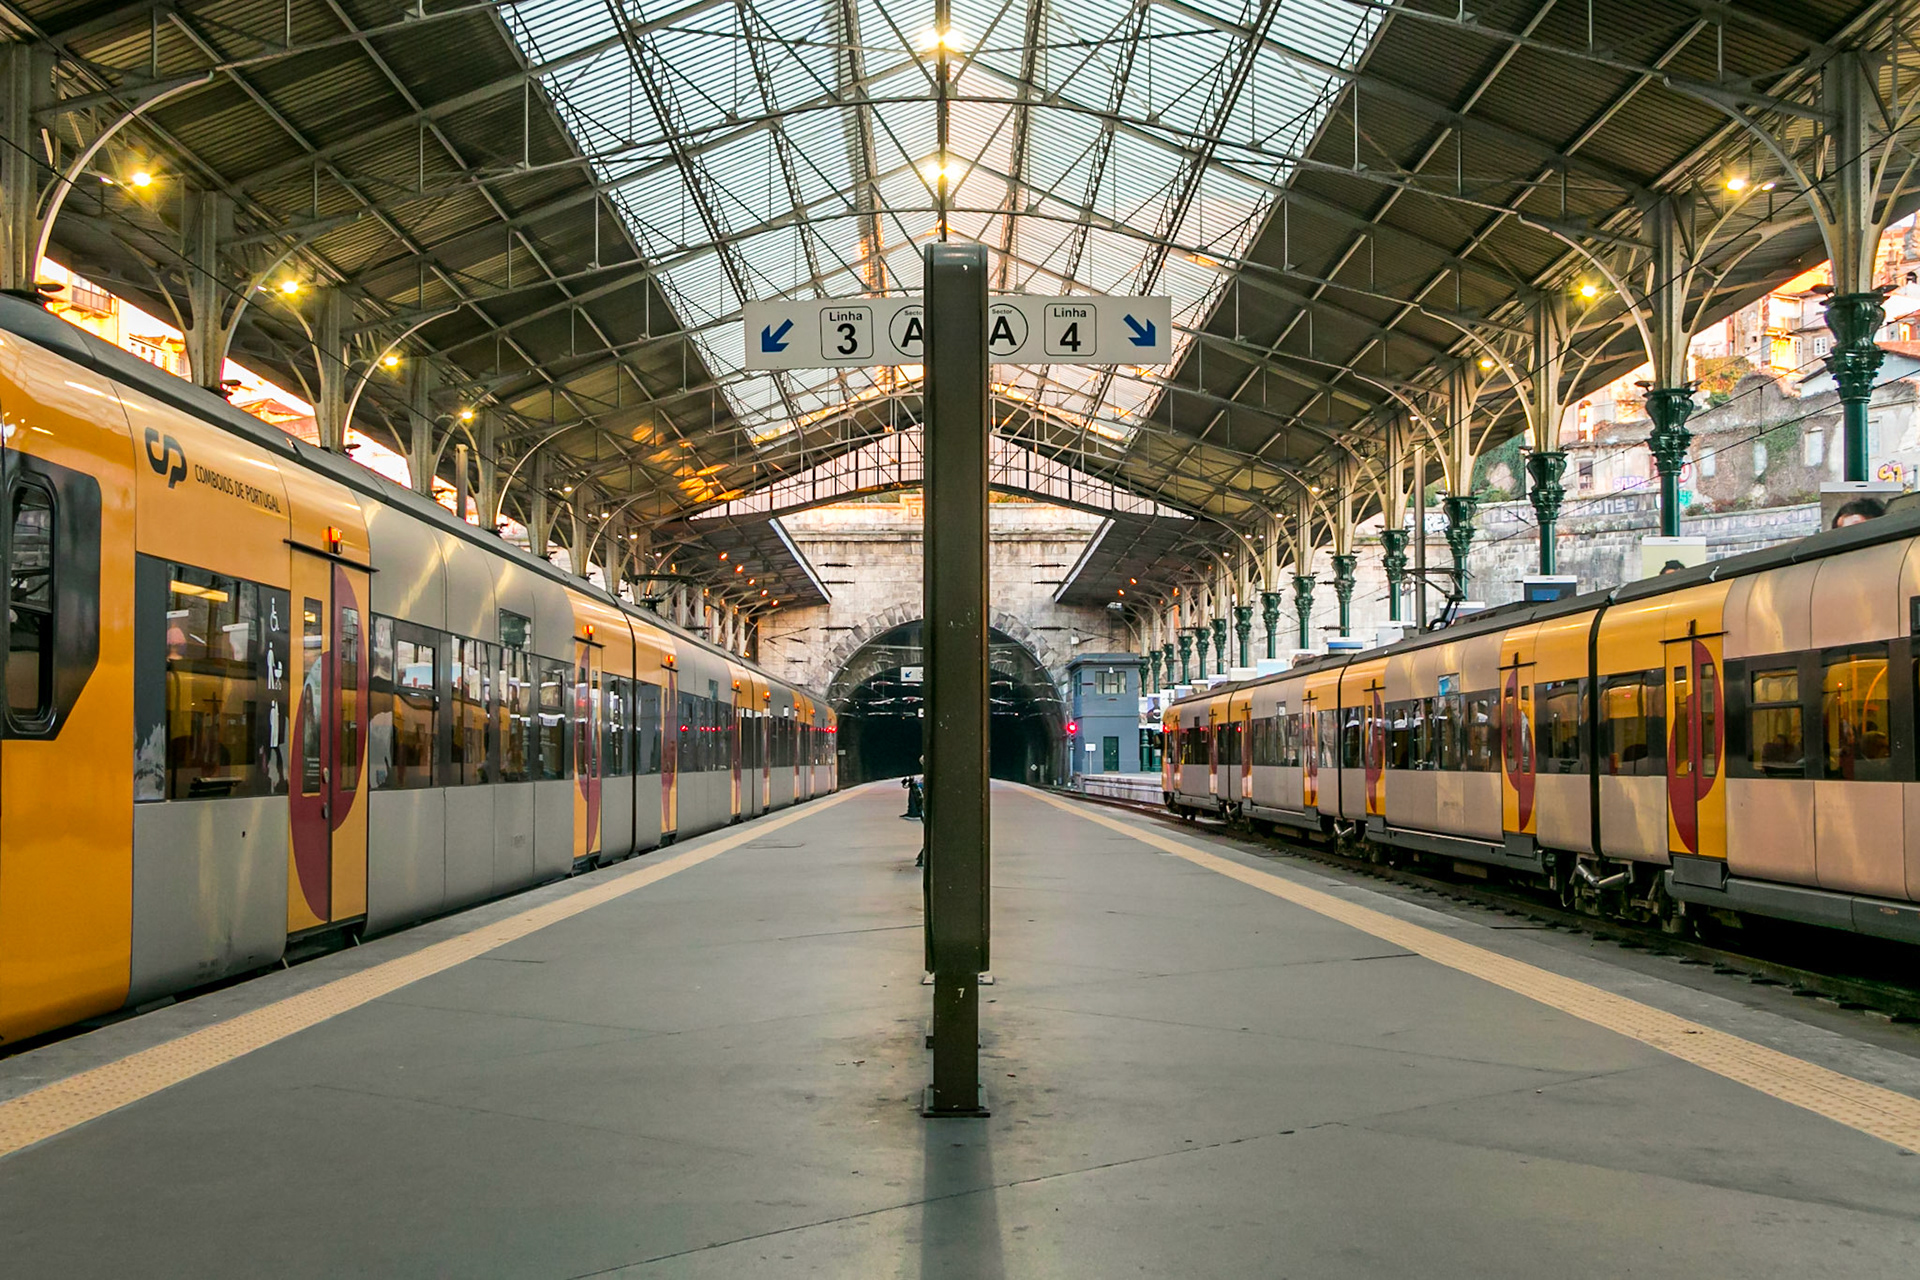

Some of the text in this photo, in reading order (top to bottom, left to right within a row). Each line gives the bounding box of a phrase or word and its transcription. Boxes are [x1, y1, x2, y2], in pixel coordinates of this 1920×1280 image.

[829, 311, 863, 322] Linha
[1053, 307, 1087, 318] Linha
[837, 323, 858, 355] 3
[901, 317, 923, 348] A
[989, 316, 1017, 346] A
[1059, 322, 1081, 352] 4
[194, 464, 281, 513] COMBOIOS DE PORTUGAL
[957, 987, 966, 999] 7
